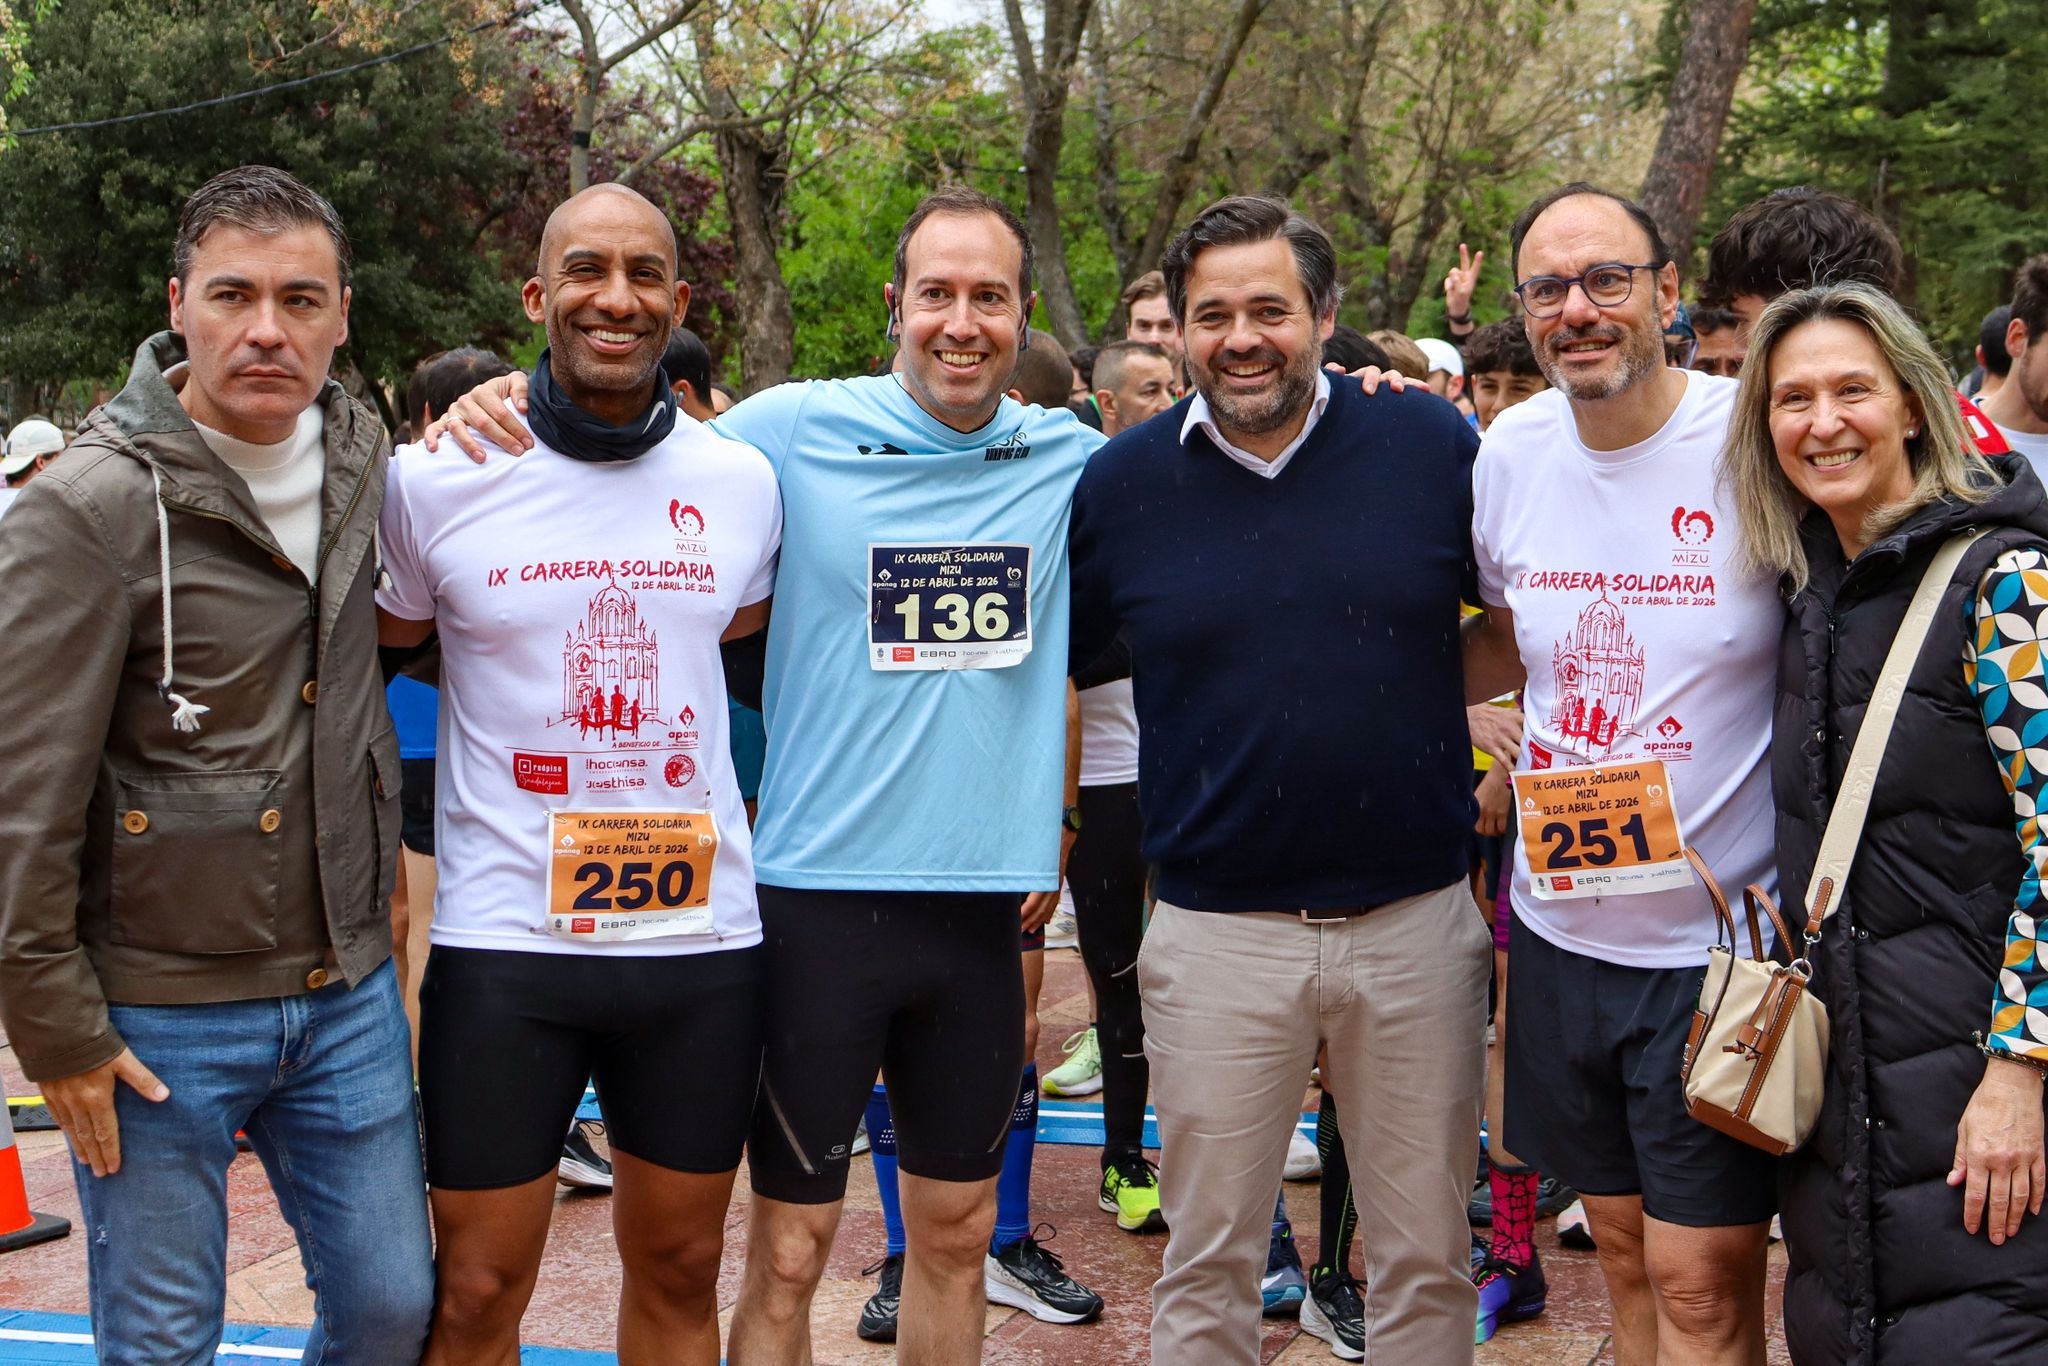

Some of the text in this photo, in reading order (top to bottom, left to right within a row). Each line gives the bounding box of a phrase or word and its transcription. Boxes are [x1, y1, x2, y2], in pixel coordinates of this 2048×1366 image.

[894, 552, 1005, 564] IX CARRERA SOLIDARIA
[488, 560, 715, 587] IX CARRERA SOLIDARIA
[940, 565, 962, 575] MIZU
[642, 581, 654, 589] DE
[657, 582, 682, 591] ABRIL
[685, 583, 695, 591] DE
[698, 584, 716, 593] 2026
[900, 576, 999, 588] 12 DE ABRIL DE 2026
[1530, 572, 1606, 592] CARRERA
[1612, 574, 1716, 595] SOLIDARIA
[1620, 596, 1716, 606] 12 DE ABRIL DE 2026
[894, 592, 1010, 641] 136
[668, 731, 698, 741] apanag
[1644, 742, 1692, 752] apanag
[533, 764, 562, 772] redpiso
[1534, 770, 1640, 791] IX CARRERA SOLIDARIA
[1576, 788, 1598, 800] MIZU
[1543, 806, 1551, 816] 12
[1553, 805, 1564, 814] DE
[1568, 803, 1596, 814] ABRIL
[1600, 800, 1612, 810] DE
[1615, 797, 1639, 808] 2026
[578, 819, 692, 830] IX CARRERA SOLIDARIA
[626, 832, 650, 842] MIZU
[1541, 813, 1652, 869] 251
[584, 845, 593, 855] 12
[597, 845, 610, 854] DE
[614, 845, 645, 855] ABRIL
[648, 845, 662, 854] DE
[664, 844, 688, 854] 2026
[572, 860, 694, 910] 250
